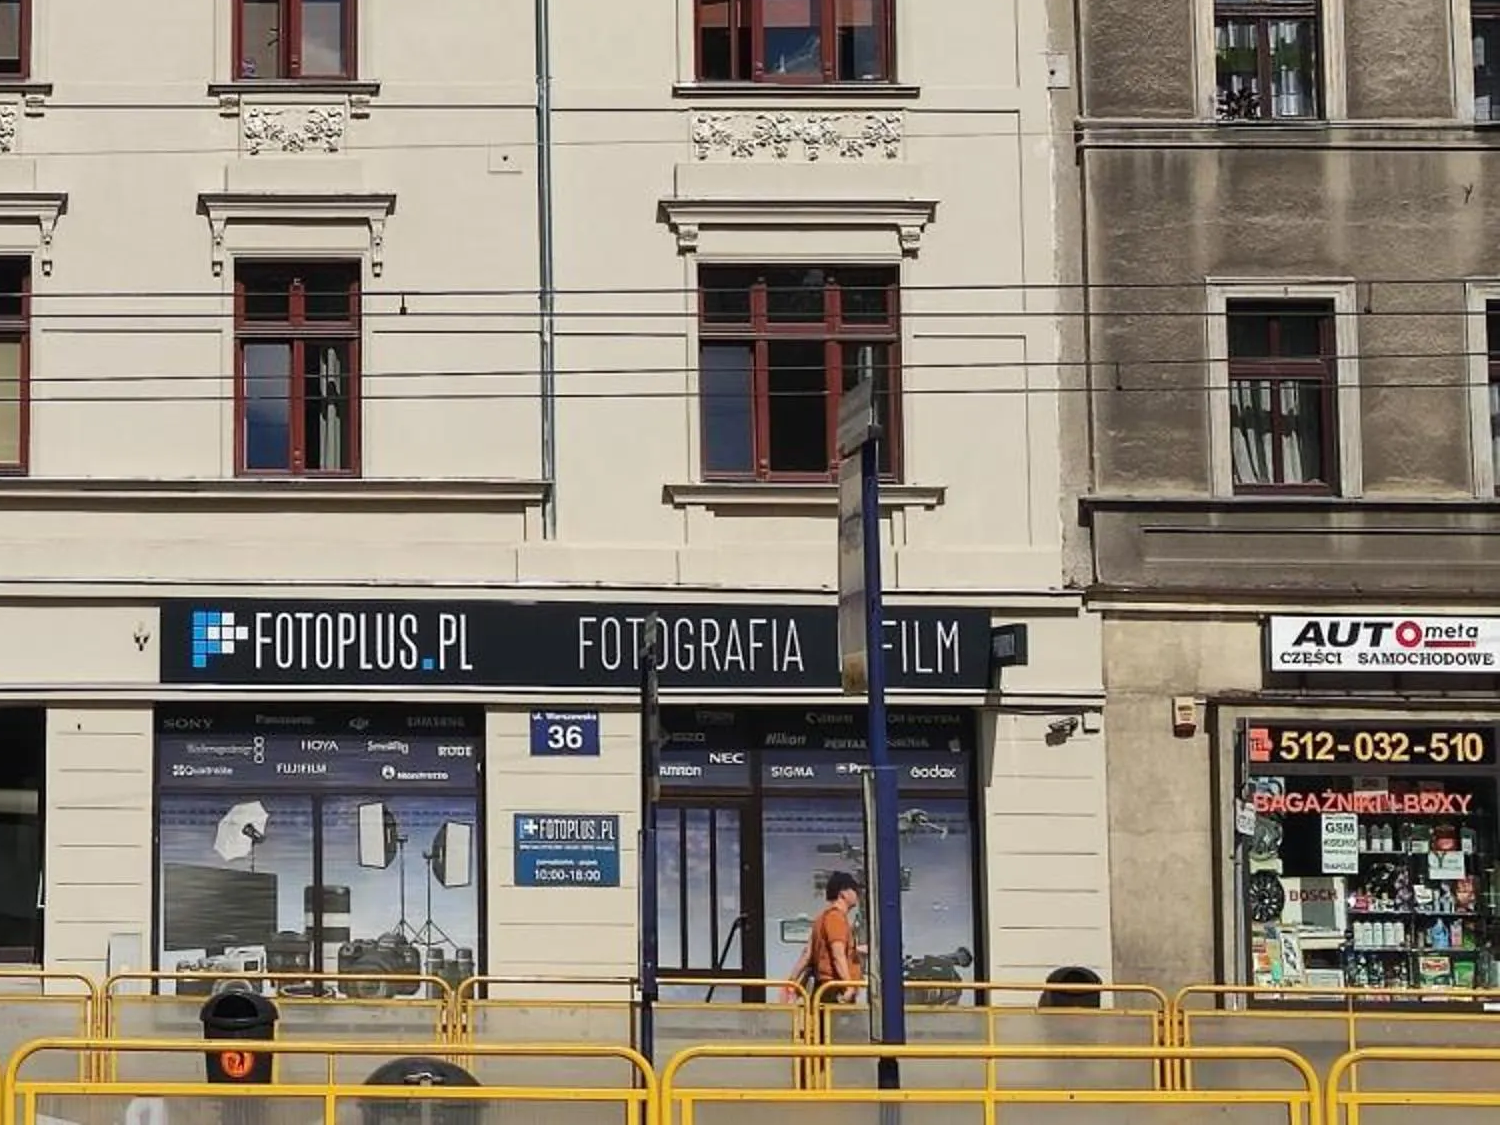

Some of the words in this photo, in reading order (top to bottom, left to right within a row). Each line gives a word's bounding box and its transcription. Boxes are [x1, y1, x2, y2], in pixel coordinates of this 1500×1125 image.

[255, 612, 473, 671] FOTOPLUS.PL
[579, 617, 804, 673] FOTOGRAFIA
[1280, 649, 1342, 666] CZĘŚCI
[1358, 653, 1494, 666] SAMOCHODOWE
[301, 740, 339, 751] HOYA
[547, 725, 583, 749] 36
[765, 732, 808, 746] Nikon
[1280, 732, 1483, 762] 512-032-510
[709, 752, 744, 764] NEC
[276, 762, 327, 774] FUJIFILM
[771, 766, 815, 778] SIGMA
[1403, 794, 1472, 814] BOXY
[540, 818, 616, 840] FOTOPLUS.PL
[1325, 822, 1355, 834] GSM
